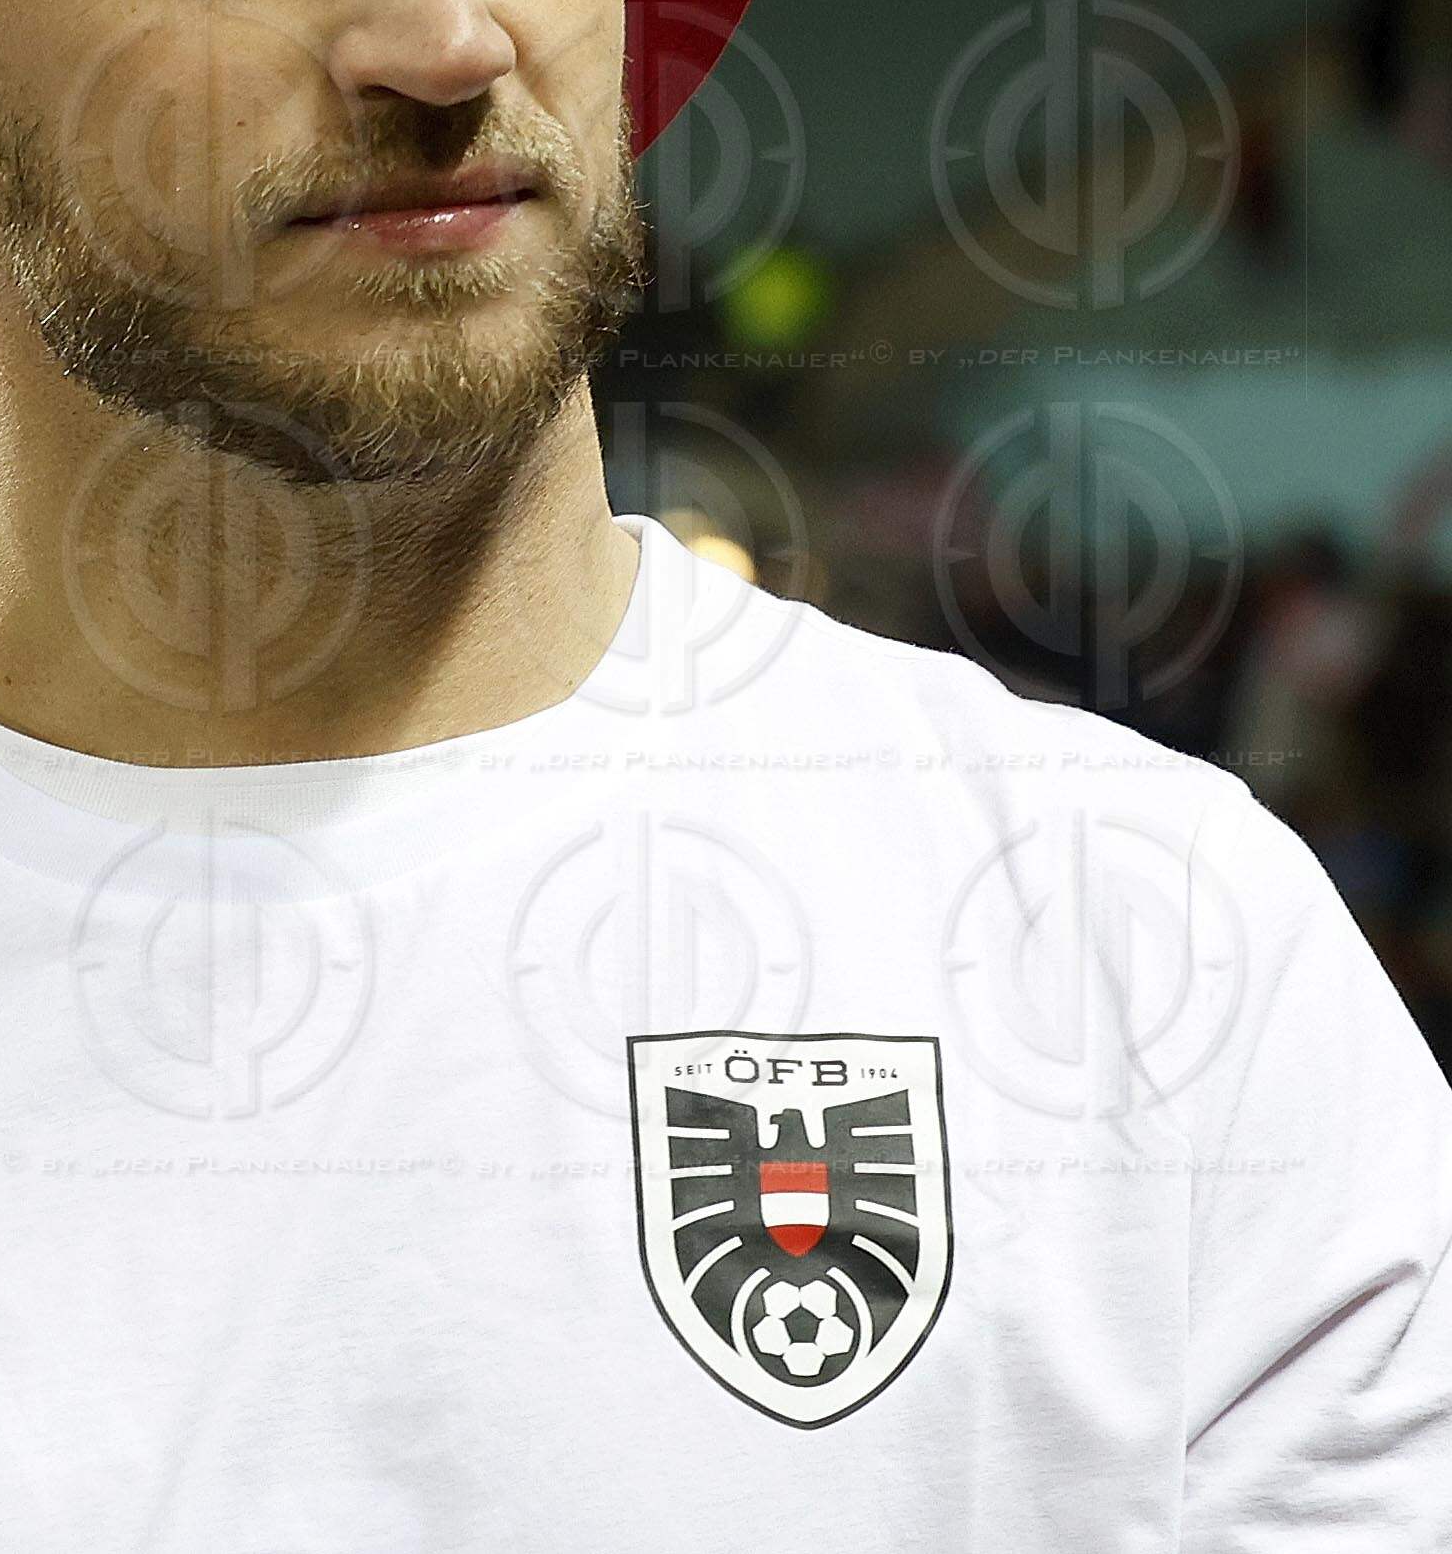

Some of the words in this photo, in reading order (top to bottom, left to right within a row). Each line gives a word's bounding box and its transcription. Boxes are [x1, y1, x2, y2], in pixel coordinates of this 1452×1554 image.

[674, 1062, 713, 1077] SEIT
[724, 1049, 849, 1087] ÖFB
[861, 1067, 899, 1080] 1904
